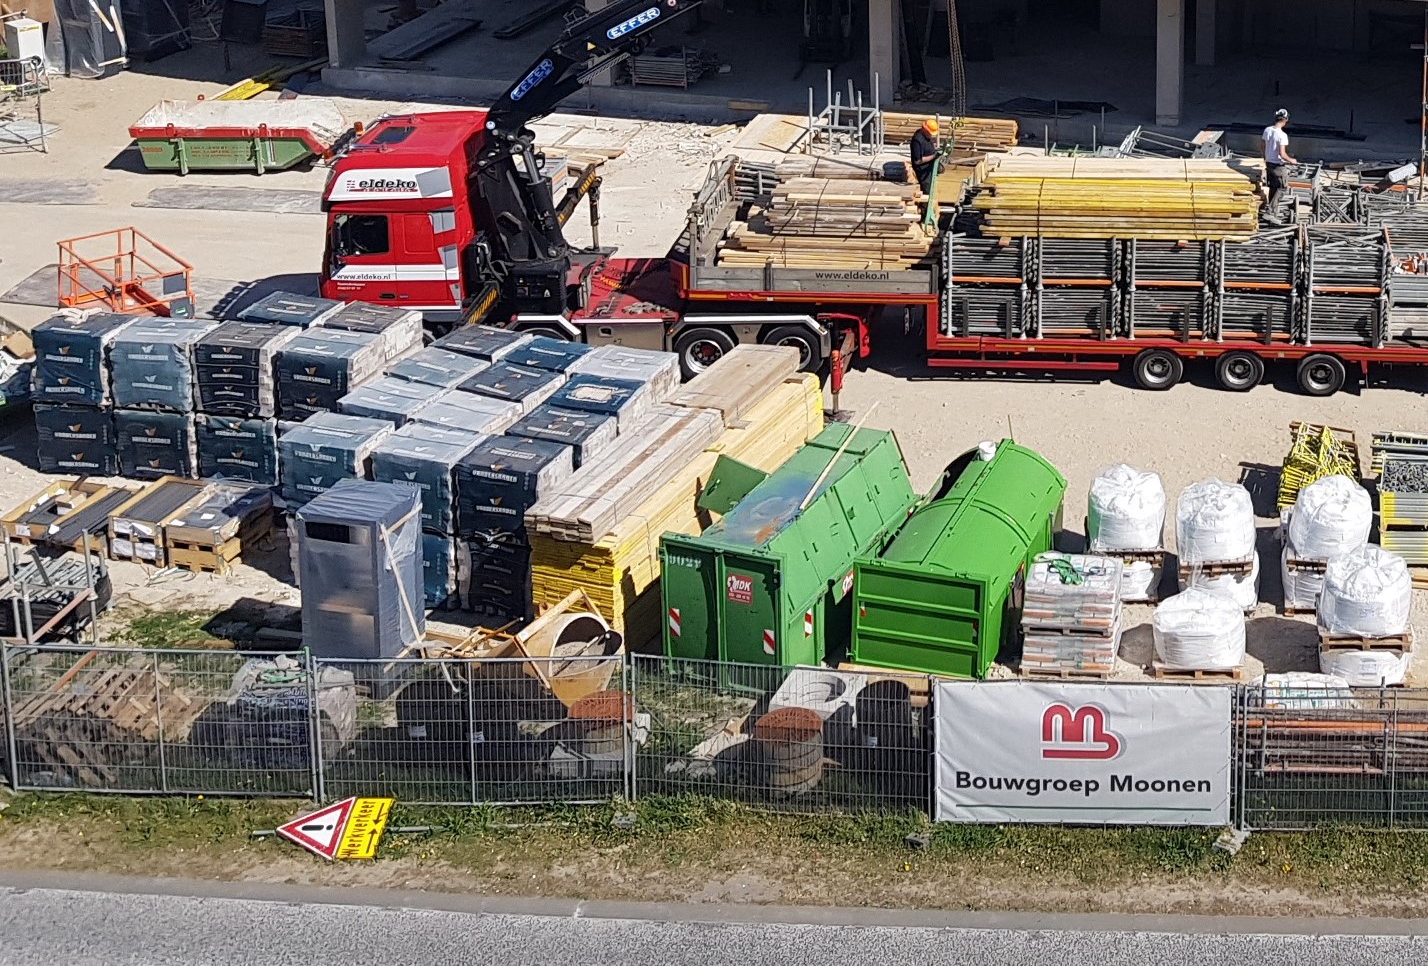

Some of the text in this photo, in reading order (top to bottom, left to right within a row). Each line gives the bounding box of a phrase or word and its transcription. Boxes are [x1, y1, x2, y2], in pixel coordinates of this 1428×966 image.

[610, 8, 659, 38] EFFER
[514, 60, 552, 99] EFFER
[359, 178, 417, 188] eldeko
[815, 270, 889, 280] www.eldeko.nl
[955, 771, 1211, 797] Bouwgroep Moonen
[341, 800, 376, 857] Werkverkeer
